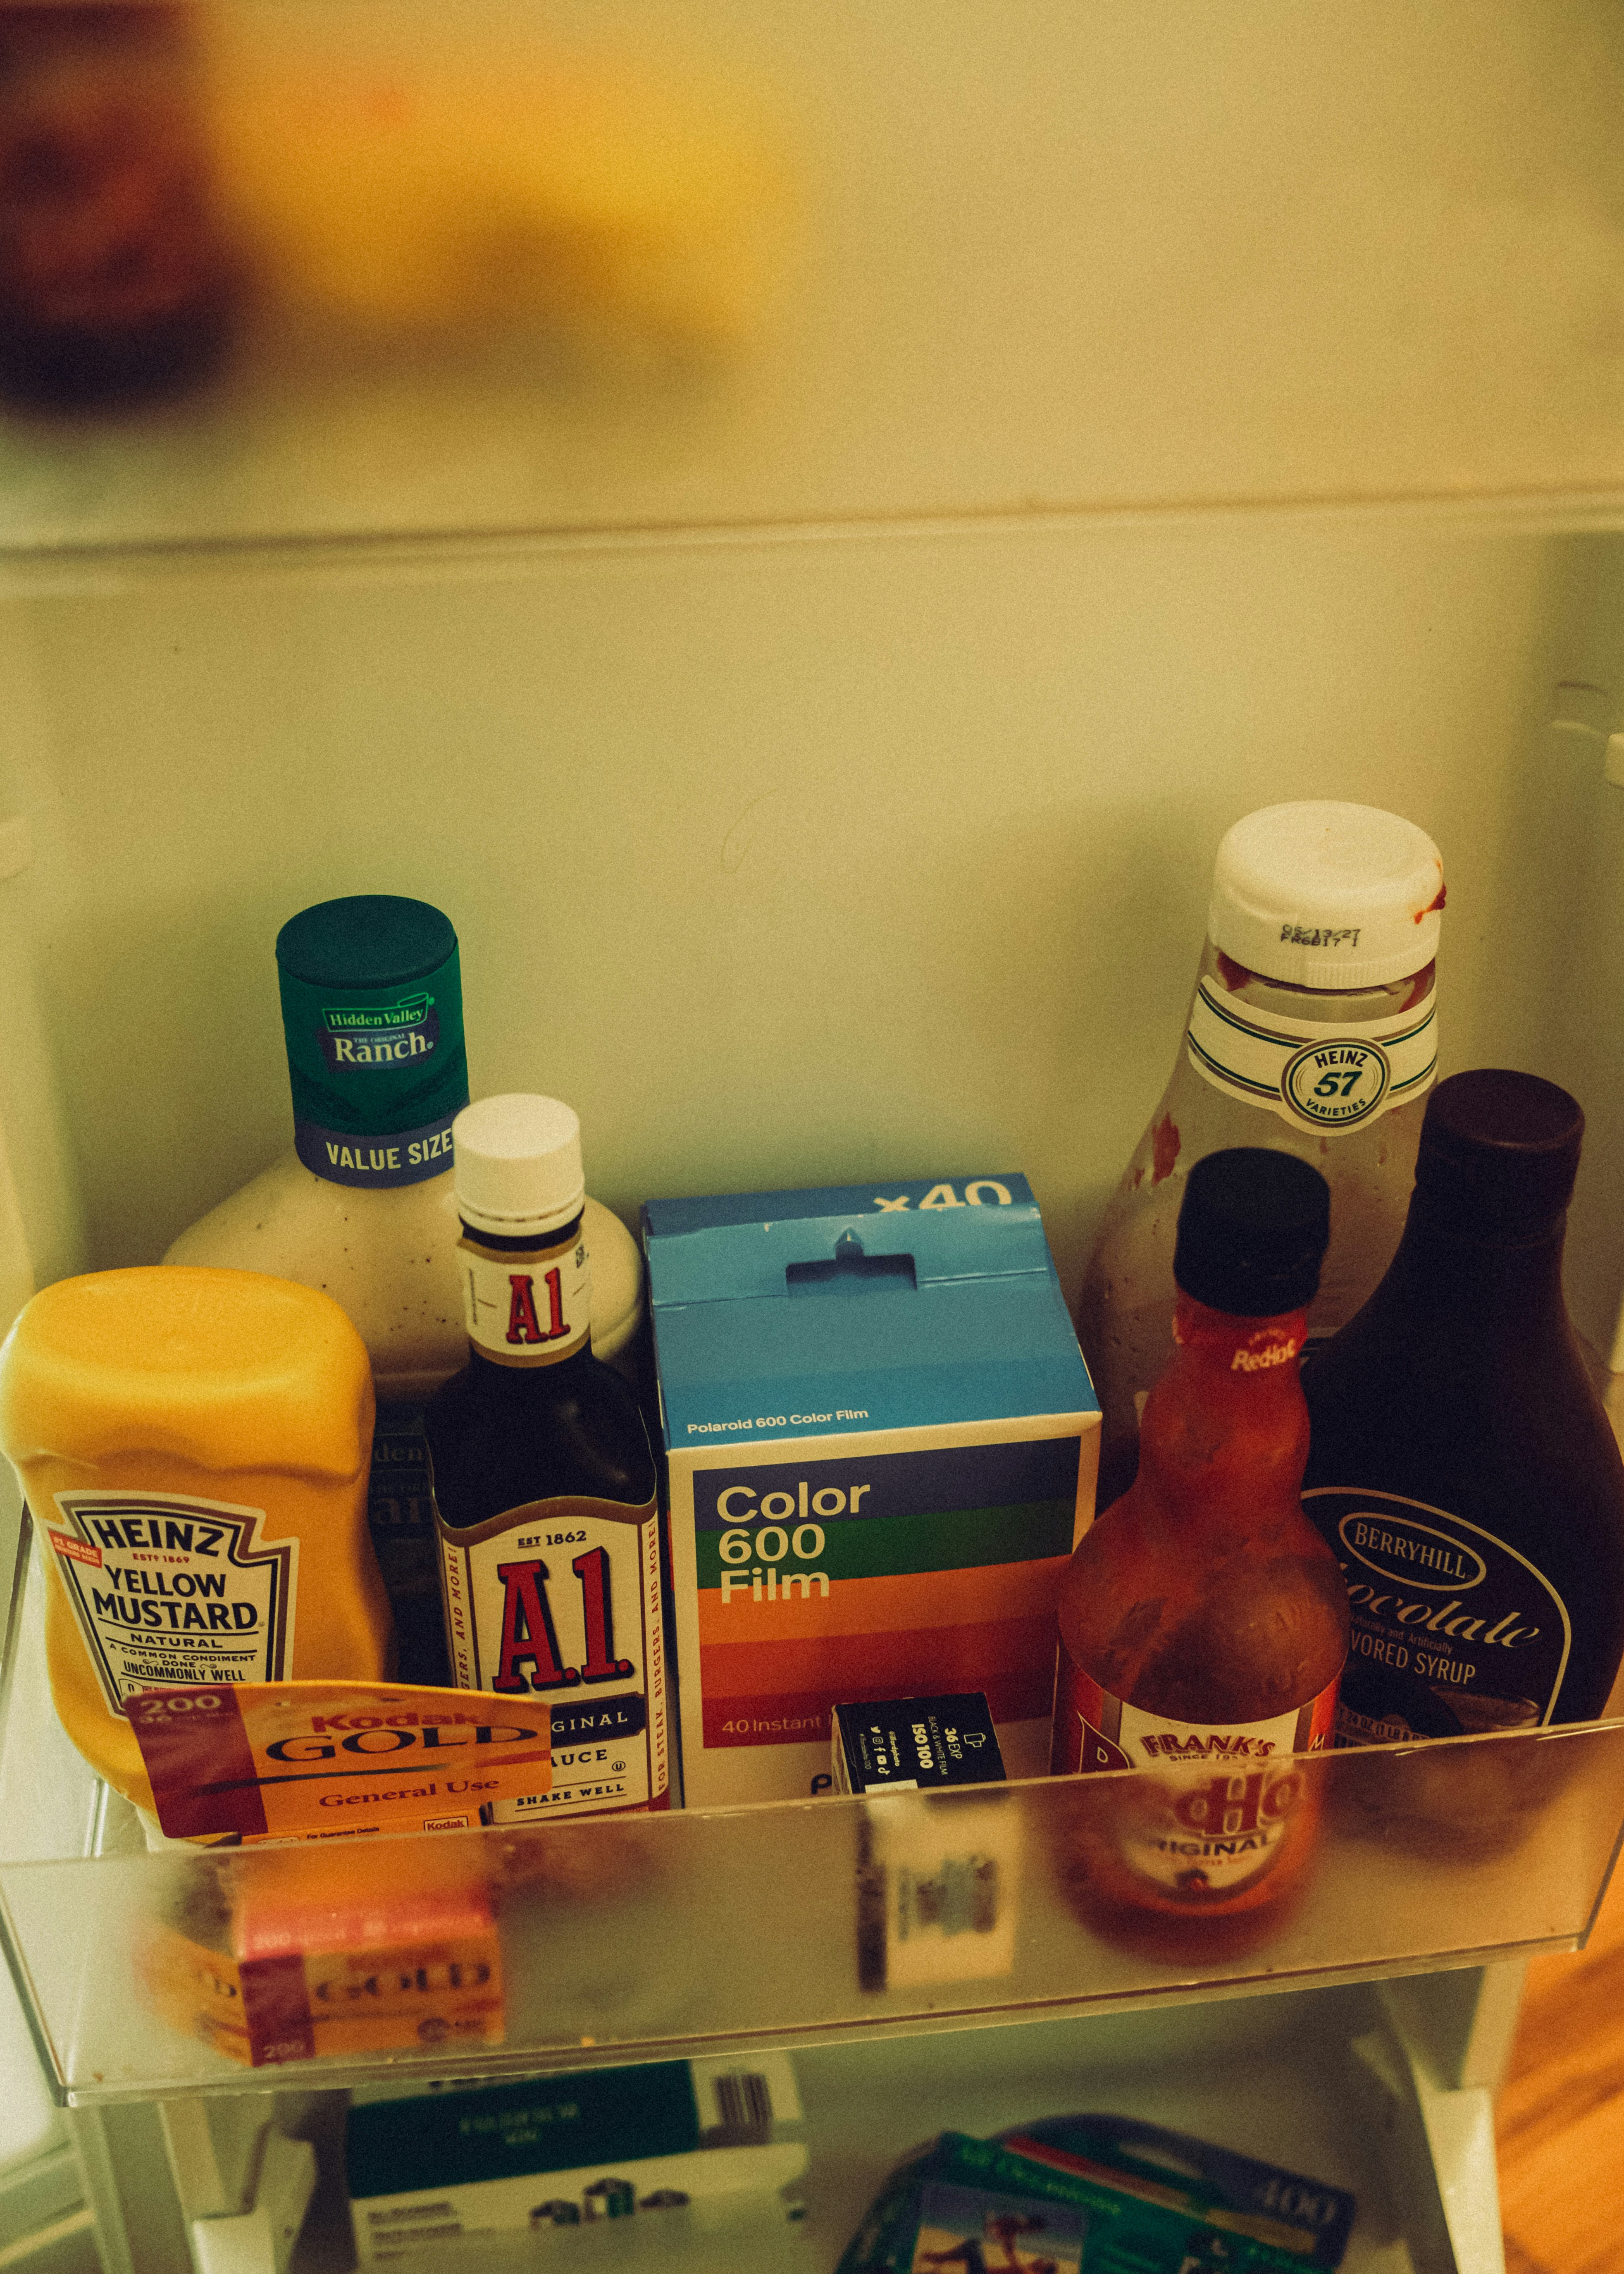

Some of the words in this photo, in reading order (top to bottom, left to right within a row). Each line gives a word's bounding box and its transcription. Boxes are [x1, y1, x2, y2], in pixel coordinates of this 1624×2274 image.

[330, 1014, 382, 1026] Hidden
[384, 1009, 424, 1022] Valley
[334, 1032, 427, 1063] Ranch
[370, 1034, 405, 1042] ORIGINAL
[1314, 1050, 1368, 1068] HEINZ
[1314, 1071, 1363, 1096] 57
[1306, 1098, 1366, 1116] VARIETIES
[326, 1142, 401, 1170] VALUE
[408, 1127, 453, 1164] SIZE
[687, 1419, 753, 1434] Polaroid
[756, 1415, 787, 1428] 600
[789, 1412, 833, 1425] Color
[835, 1409, 869, 1421] Film
[717, 1481, 870, 1523] Color
[91, 1519, 224, 1557] HEINZ
[517, 1536, 541, 1546] EST
[546, 1530, 587, 1545] 1862
[648, 1520, 657, 1575] MORE!
[719, 1523, 825, 1565] 600
[163, 1555, 190, 1564] 1869
[1354, 1522, 1467, 1579] BERRYHILL
[104, 1565, 226, 1598] YELLOW
[448, 1547, 461, 1600] MORE!
[721, 1567, 830, 1603] Film
[651, 1581, 659, 1613] AND
[92, 1588, 258, 1630] MUSTARD
[1347, 1584, 1543, 1648] ocolate
[454, 1607, 465, 1641] AND
[131, 1634, 223, 1648] NATURAL
[1388, 1629, 1404, 1641] and
[1408, 1633, 1453, 1655] Artificially
[121, 1647, 177, 1660] COMMON
[162, 1660, 196, 1668] DONE
[1351, 1630, 1409, 1668] VORED
[1414, 1653, 1476, 1684] SYRUP
[124, 1661, 206, 1680] UNCOMMONLY
[210, 1669, 246, 1681] WELL
[140, 1695, 222, 1714] 200
[311, 1713, 484, 1732] Kodak
[551, 1712, 627, 1732] GINAL
[722, 1720, 749, 1732] 40
[753, 1716, 820, 1732] Instant
[928, 1716, 940, 1733] BLACK
[266, 1726, 538, 1762] GOLD
[911, 1724, 928, 1744] ISO
[944, 1727, 959, 1743] 36
[934, 1740, 945, 1759] WHITE
[948, 1744, 962, 1759] EXP
[1140, 1734, 1276, 1757] FRANK'S
[917, 1745, 934, 1769] 100
[939, 1761, 948, 1775] FILM
[319, 1783, 436, 1807] General
[446, 1780, 499, 1793] Use
[517, 1791, 572, 1806] SHAKE
[580, 1784, 625, 1796] WELL
[427, 1820, 464, 1831] Kodak
